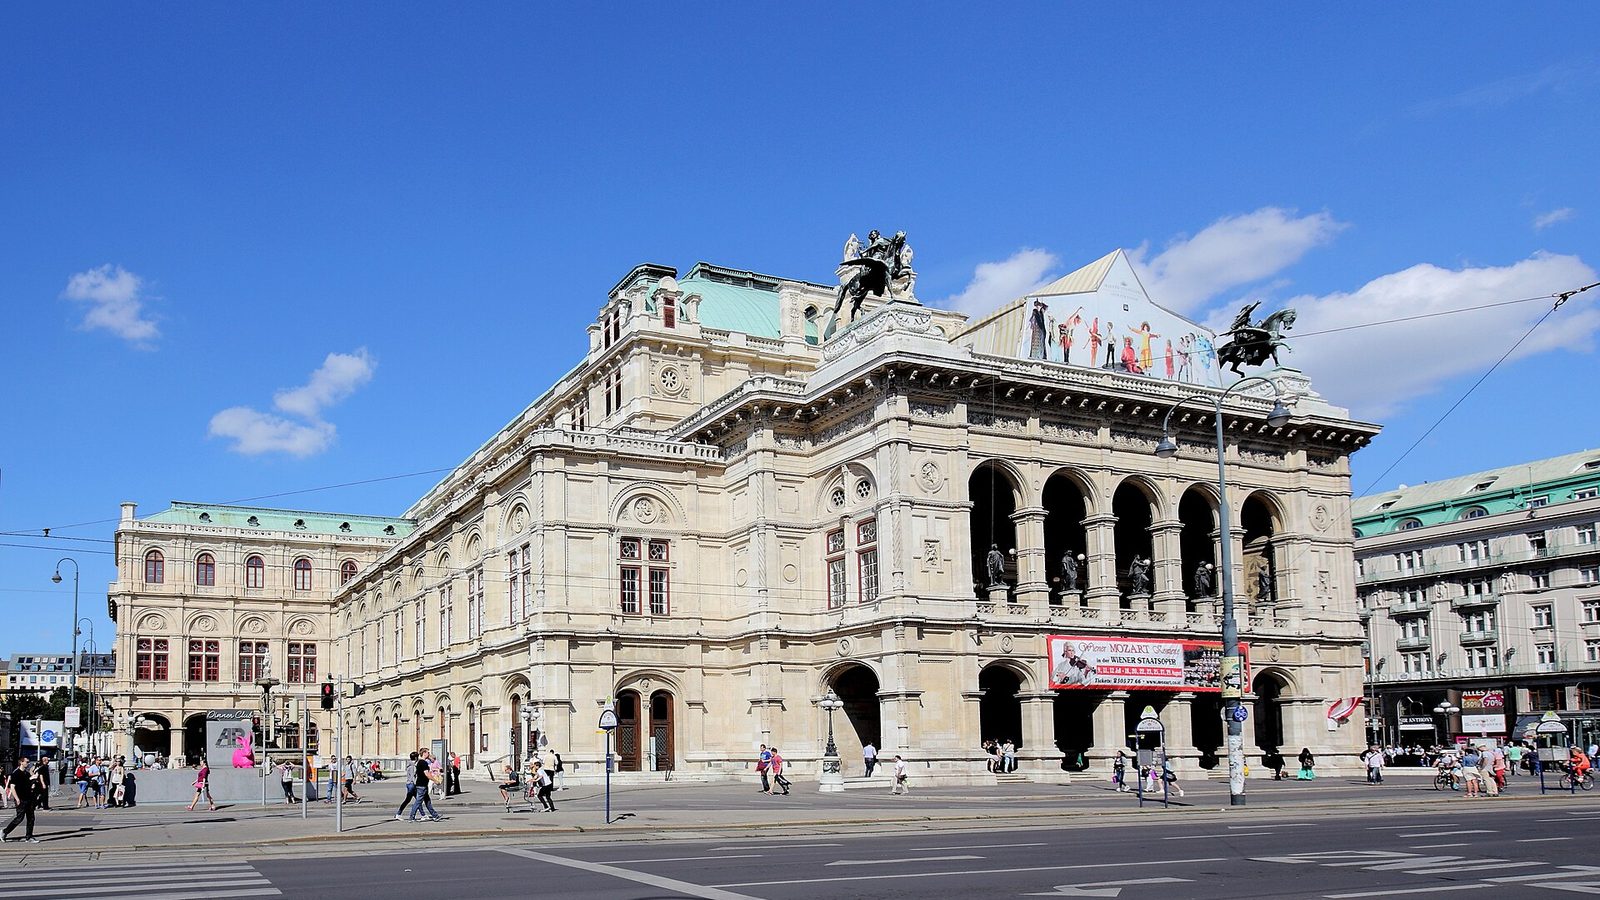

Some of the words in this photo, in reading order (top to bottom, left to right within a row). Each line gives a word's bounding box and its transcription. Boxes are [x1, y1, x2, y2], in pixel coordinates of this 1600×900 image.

[1109, 643, 1150, 654] MOZART
[1111, 656, 1136, 664] WIENER
[1137, 657, 1176, 665] STAATSOPER
[1483, 699, 1503, 707] -70%
[207, 710, 234, 719] Dinner
[235, 710, 253, 719] Club
